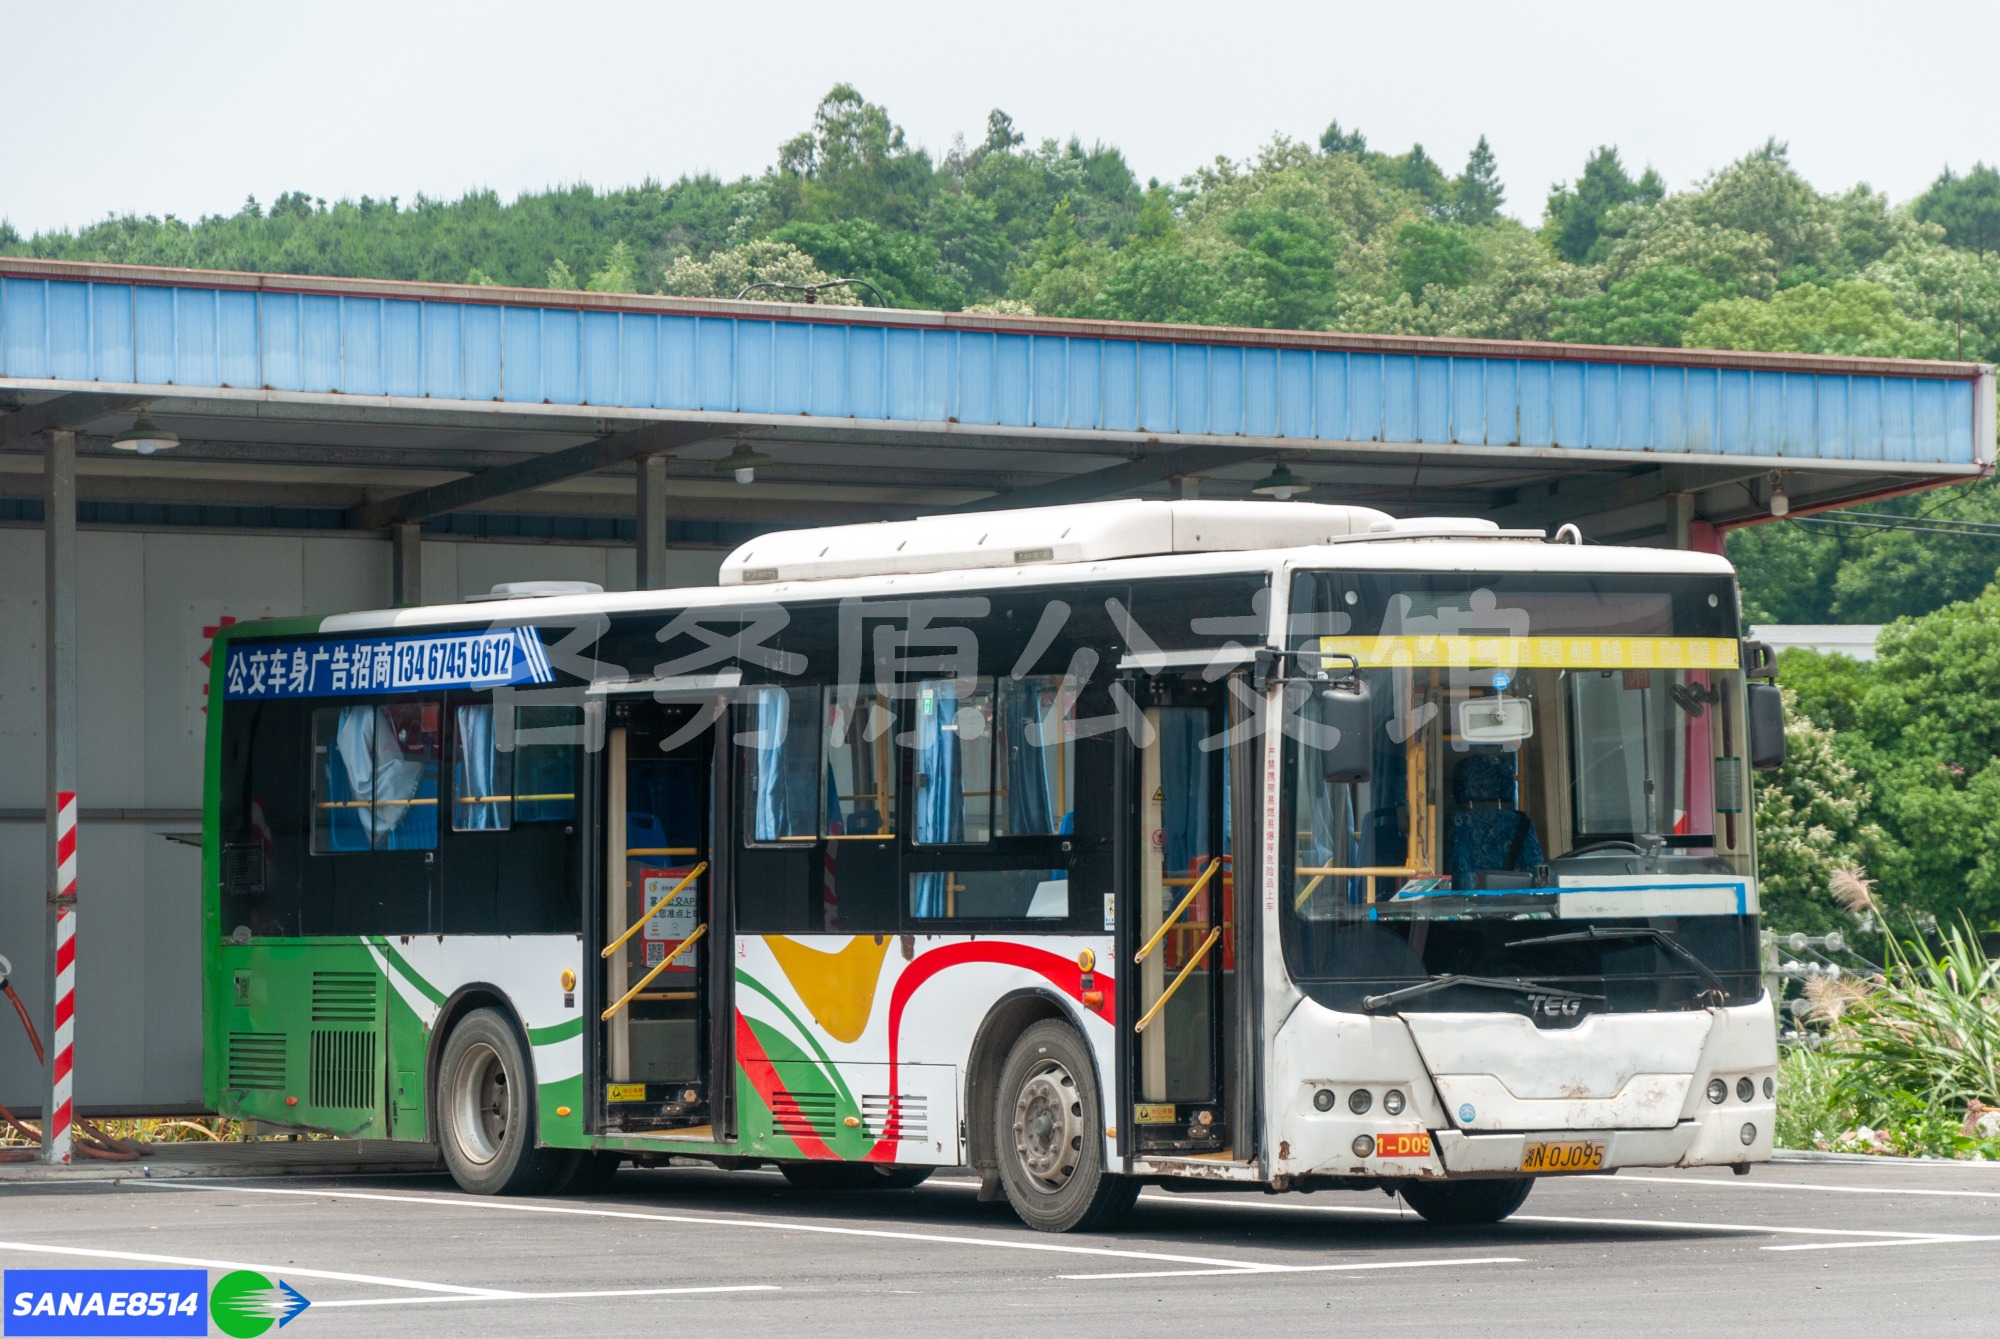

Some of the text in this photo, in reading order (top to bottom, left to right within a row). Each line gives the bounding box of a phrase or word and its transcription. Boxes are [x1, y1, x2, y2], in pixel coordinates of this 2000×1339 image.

[227, 637, 511, 694] 公交车身广告招商 134 6745 9612
[1528, 994, 1582, 1016] TEG
[1377, 1136, 1430, 1154] 1-D09
